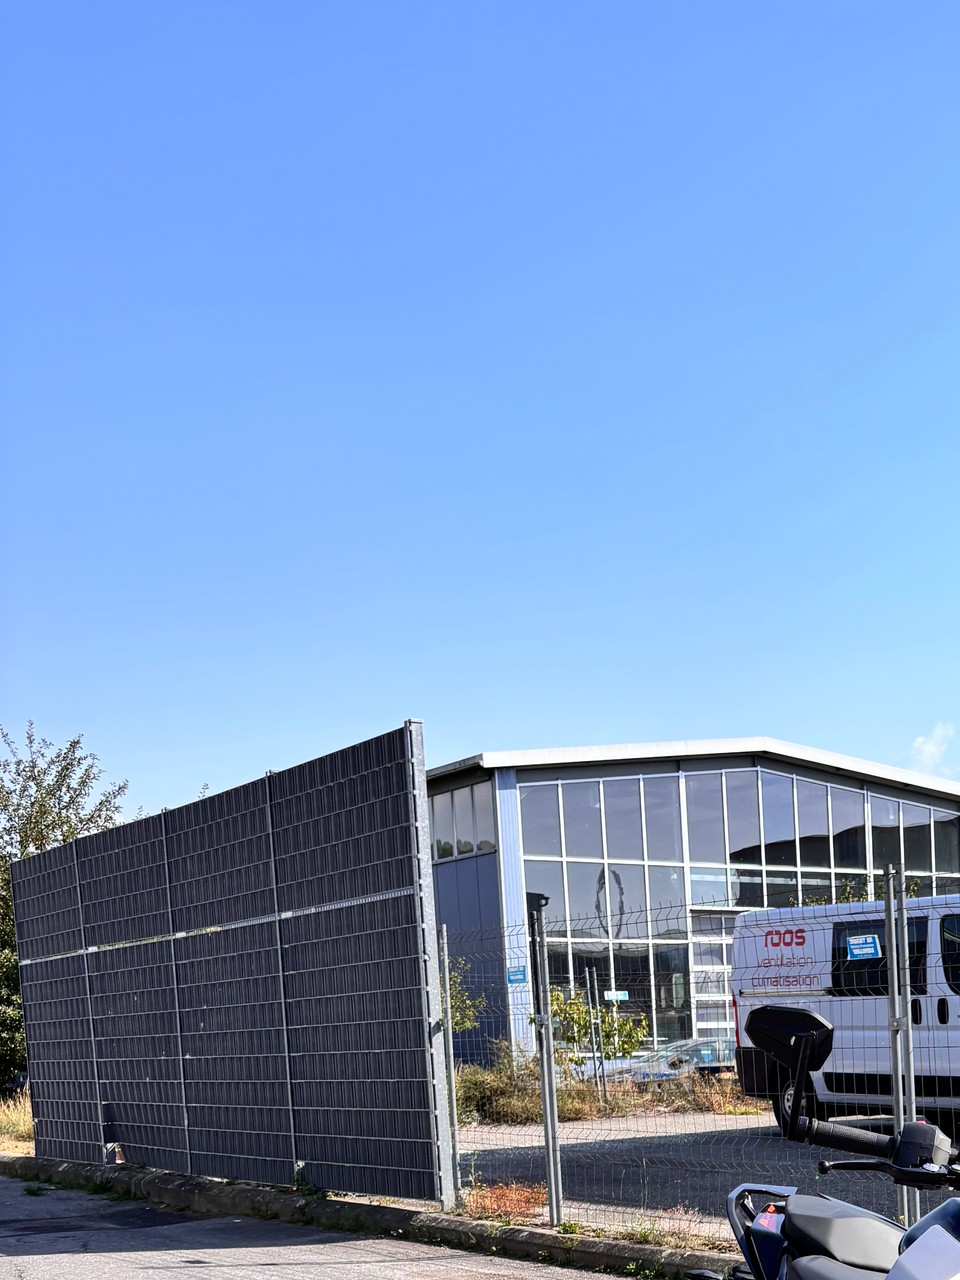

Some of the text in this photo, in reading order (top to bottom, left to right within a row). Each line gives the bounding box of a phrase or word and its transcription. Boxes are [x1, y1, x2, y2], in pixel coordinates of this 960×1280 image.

[764, 928, 806, 948] roos
[758, 954, 814, 968] ventilation
[751, 974, 819, 988] climatisation
